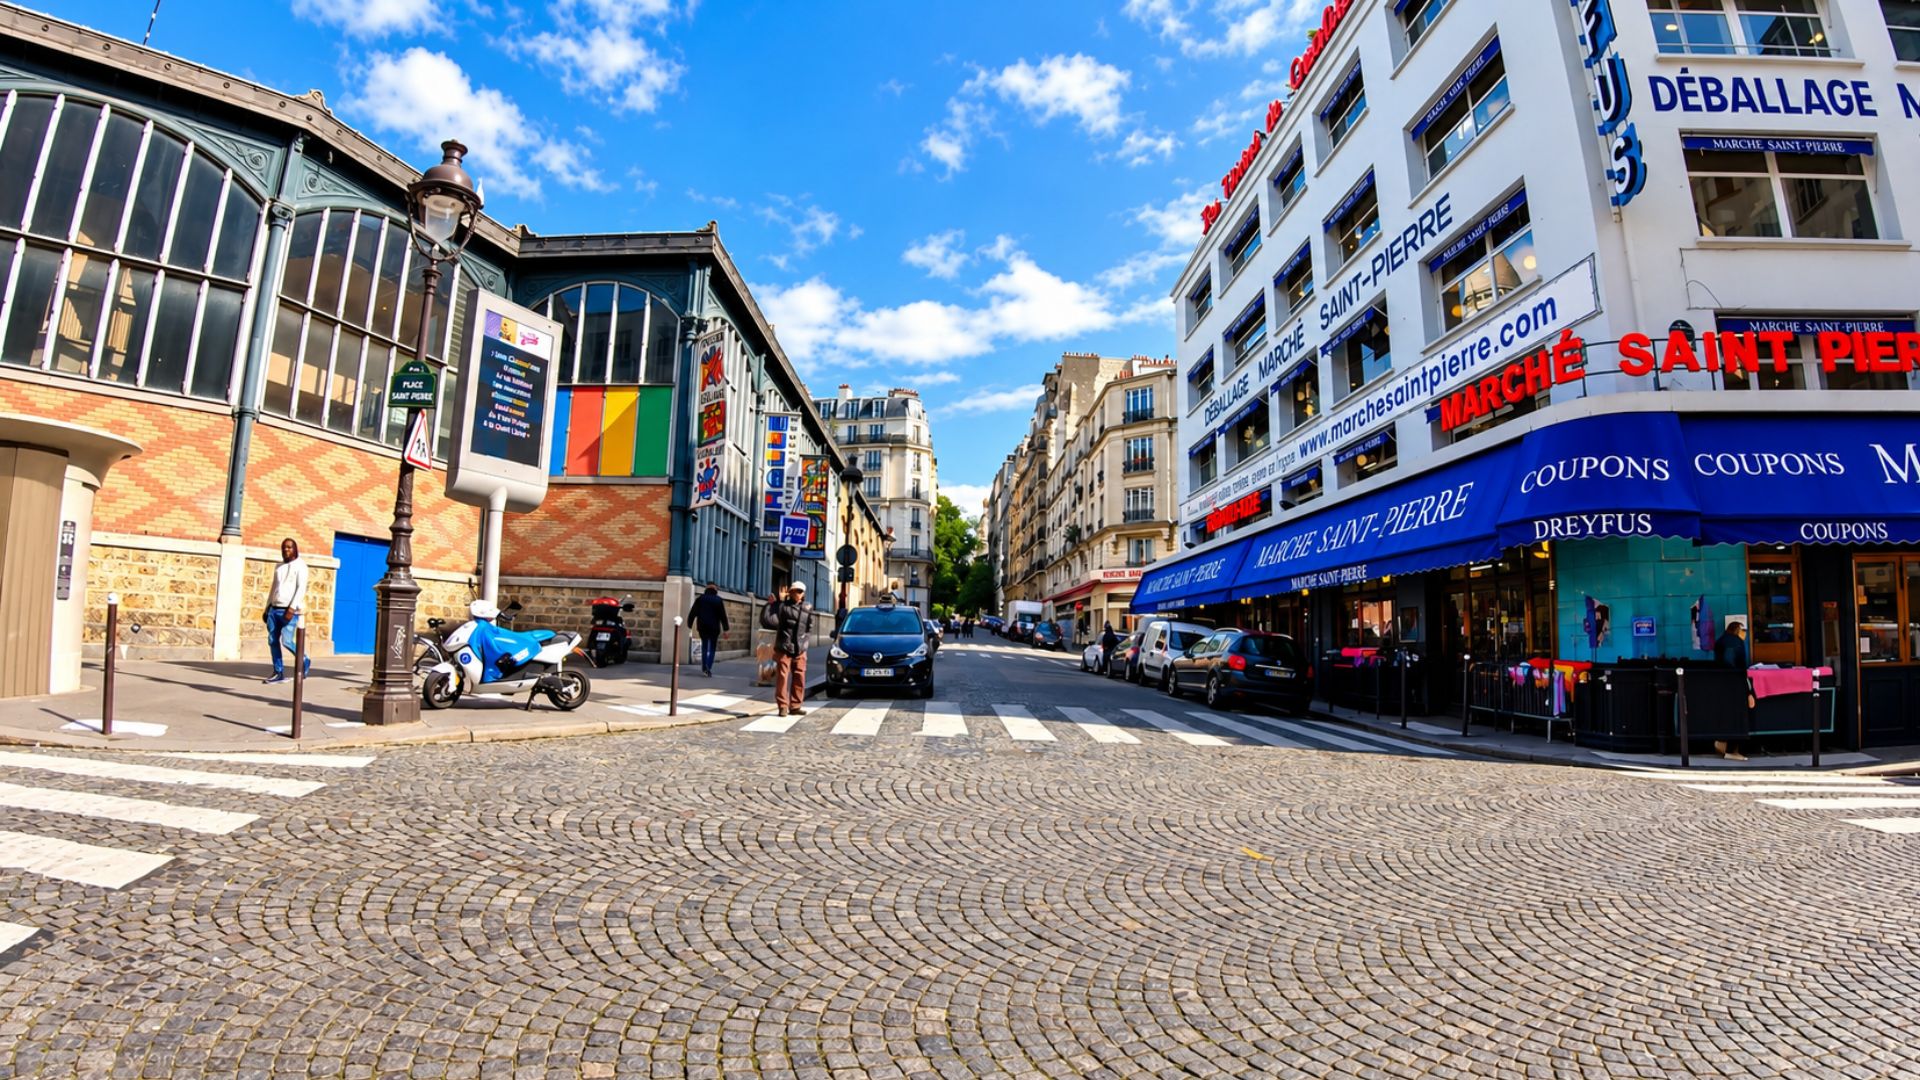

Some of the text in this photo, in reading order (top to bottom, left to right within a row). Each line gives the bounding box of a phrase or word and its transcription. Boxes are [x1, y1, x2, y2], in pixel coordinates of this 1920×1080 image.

[1648, 67, 1878, 117] DÉBALLAGE
[1713, 138, 1846, 153] MARCHE SAINT-PIERRE
[1204, 372, 1250, 427] DÉBALLAGE
[1258, 317, 1306, 383] MARCHÉ
[1319, 191, 1453, 331] SAINT-PIERRE
[1750, 321, 1886, 333] MARCHE SAINT-PIERRE
[1299, 296, 1558, 458] www.marchesaintpierre.com
[1440, 328, 1585, 432] MARCHÉ
[1618, 331, 1794, 376] SAINT
[1521, 455, 1670, 494] COUPONS
[1694, 452, 1845, 476] COUPONS
[1253, 530, 1318, 569] MARCHE
[1315, 482, 1475, 554] SAINT-PIERRE
[1534, 513, 1652, 540] DREYFUS
[1800, 522, 1889, 540] COUPONS
